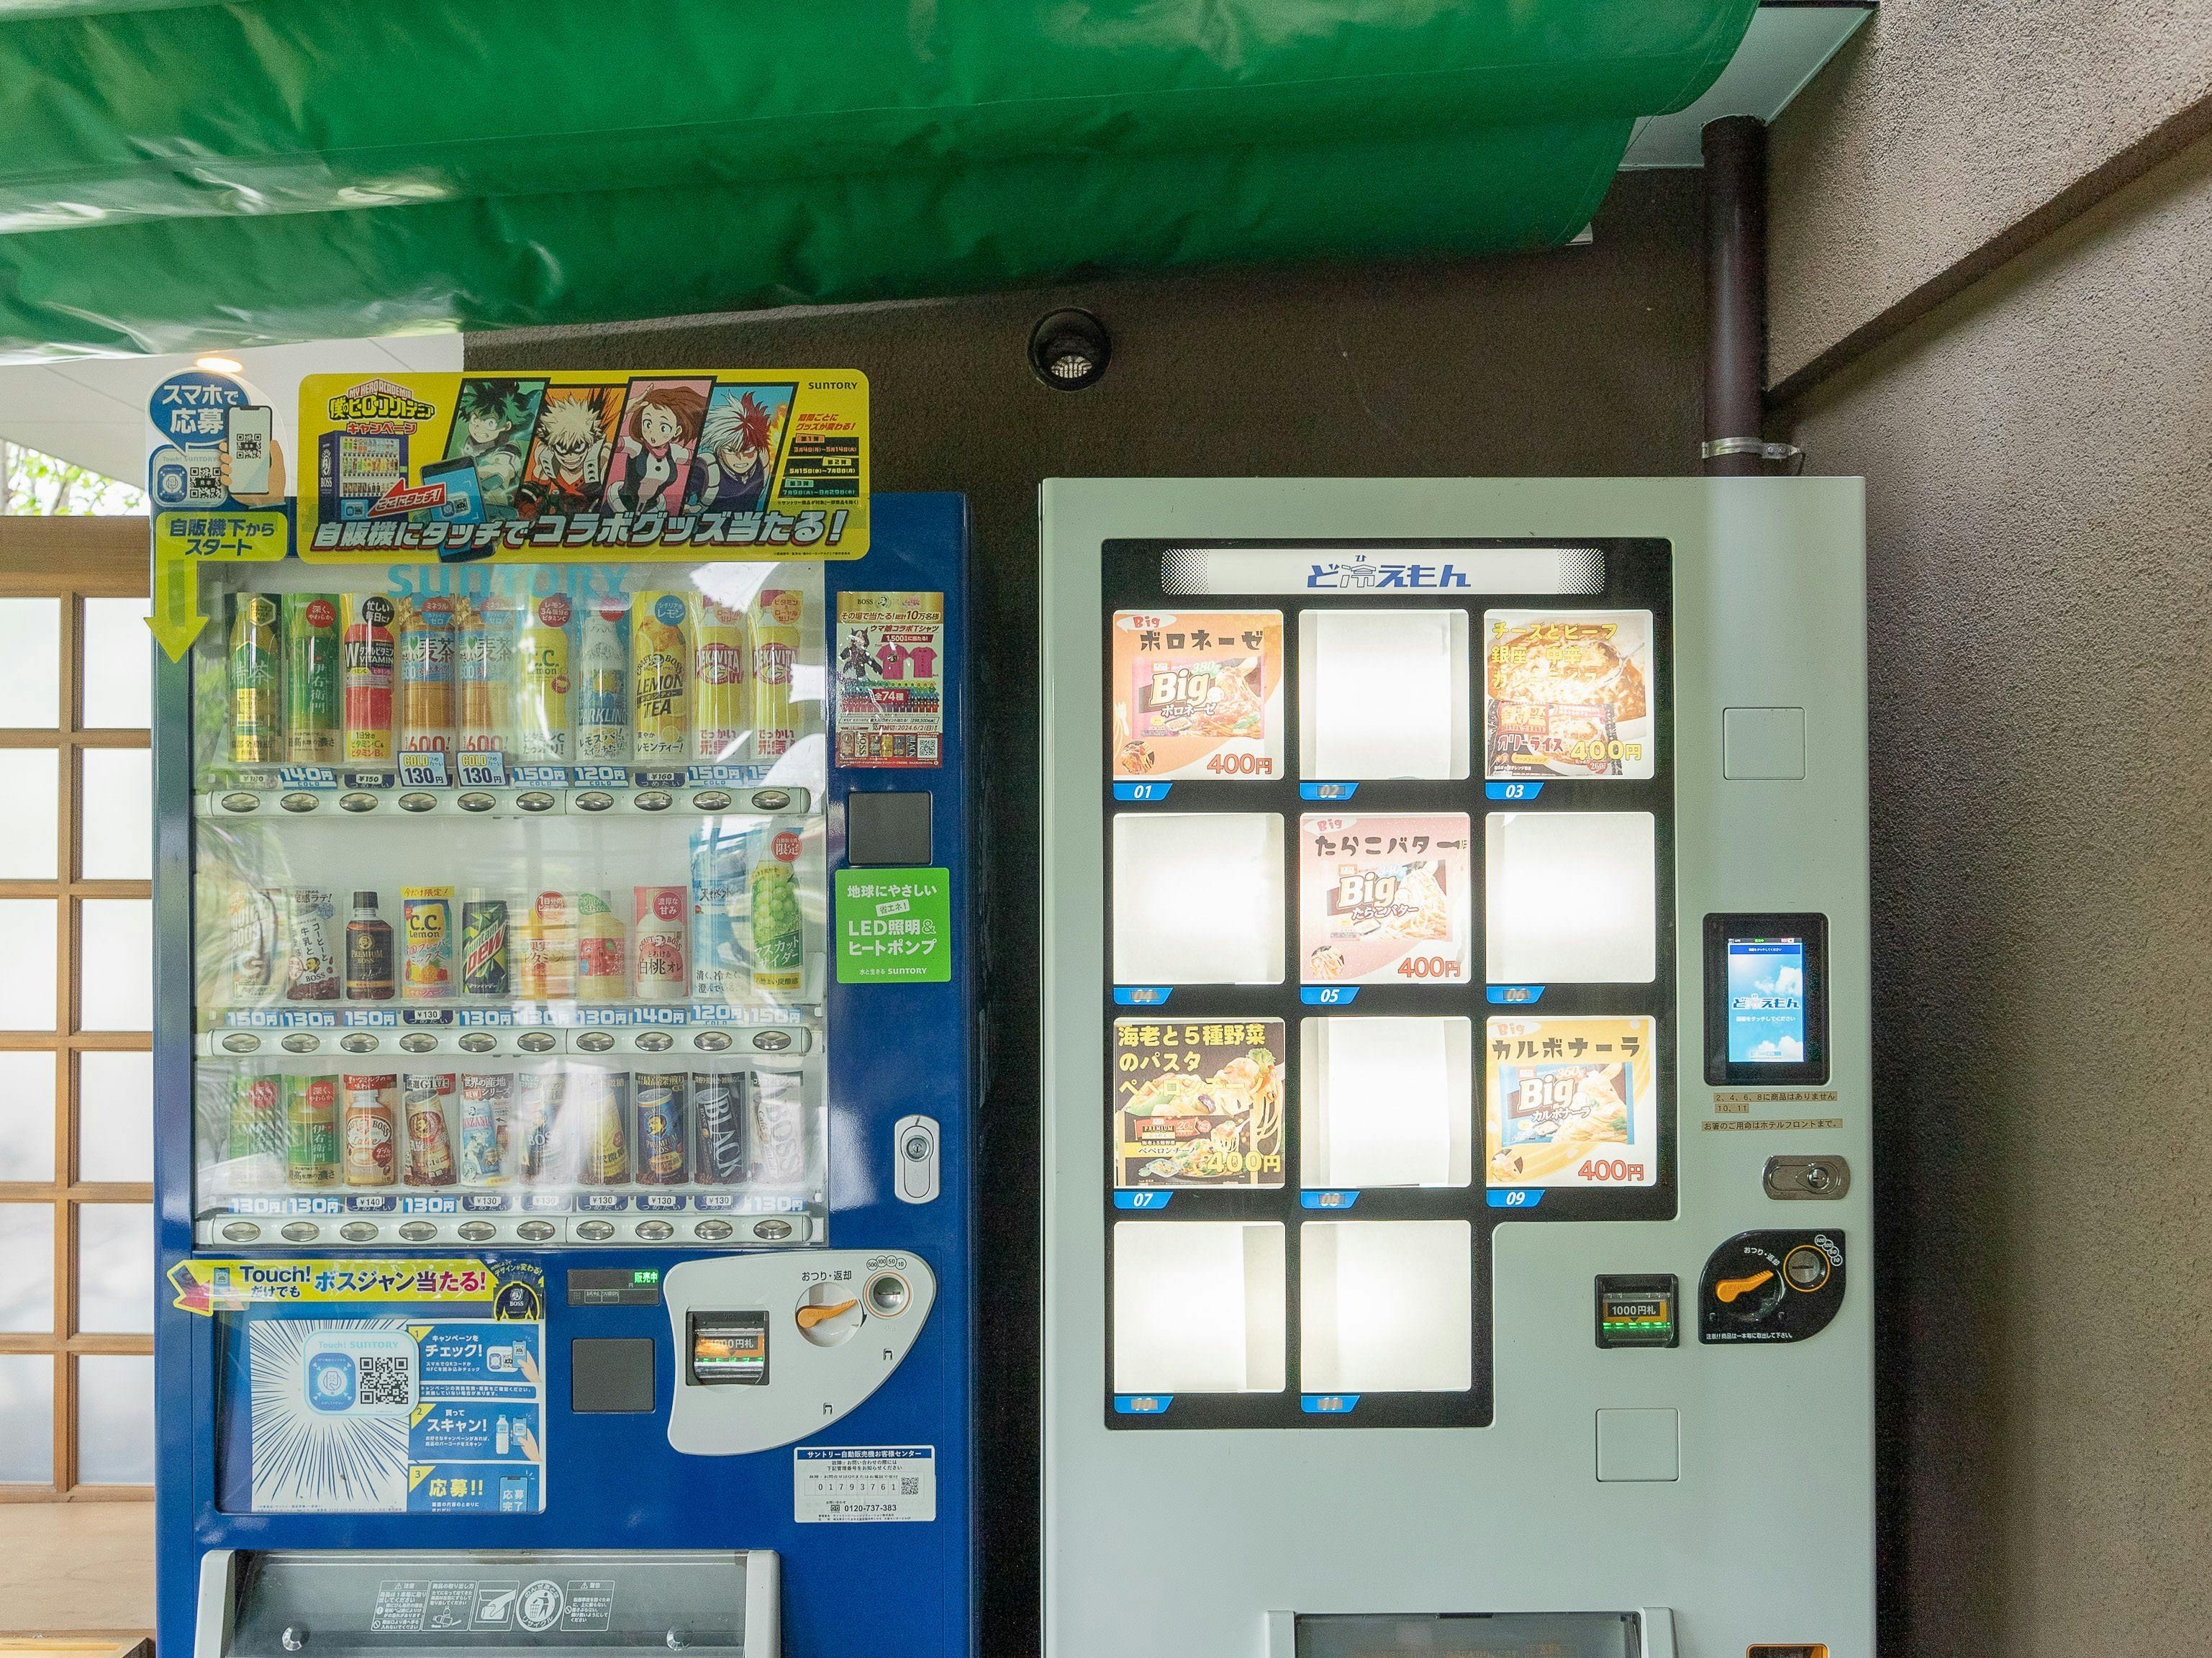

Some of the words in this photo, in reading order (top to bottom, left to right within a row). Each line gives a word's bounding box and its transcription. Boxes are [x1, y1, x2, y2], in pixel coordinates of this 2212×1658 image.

[163, 384, 239, 406] スマホで
[170, 408, 224, 435] 応募
[347, 422, 418, 435] キャンペーン
[169, 517, 276, 538] 自販機下から
[312, 509, 848, 550] 自販機にタッチでコラボグッズ当たる!
[185, 538, 253, 557] スタート
[1307, 563, 1472, 588] ど冷えもん
[366, 601, 390, 612] 忙しい
[1133, 617, 1161, 628] Big
[1492, 622, 1618, 640] チーズとビーフ
[1140, 630, 1264, 651] ボロネーゼ
[345, 643, 359, 667] W
[419, 637, 455, 662] 麦茶
[1490, 645, 1528, 664] 銀座
[637, 674, 683, 694] LEMON
[1150, 669, 1210, 707] Big
[643, 699, 671, 718] TEA
[1161, 703, 1218, 718] ボロネーゼ
[1570, 740, 1643, 761] 400円
[403, 755, 428, 766] COLD
[462, 755, 487, 766] COLD
[1207, 753, 1273, 775] 400円
[280, 768, 333, 781] 140円
[405, 767, 444, 784] 130円
[463, 767, 502, 784] 130円
[514, 766, 566, 781] 150円
[576, 766, 626, 781] 120円
[689, 766, 740, 779] 150円
[1133, 785, 1153, 799] 01
[1505, 785, 1524, 798] 03
[1317, 818, 1343, 832] Big
[776, 843, 799, 856] 限定
[1315, 835, 1468, 856] たらこバター
[847, 884, 937, 898] 地球にやさしい
[1337, 871, 1397, 910] Big
[659, 906, 677, 915] 甘み
[879, 902, 907, 915] 省エネ!
[1351, 904, 1419, 920] たらこバター
[409, 914, 442, 931] C.C.
[848, 919, 937, 936] LED照明&
[409, 930, 440, 939] Lemon
[754, 936, 799, 957] マスカット
[849, 938, 937, 956] ヒートポンプ
[640, 959, 682, 975] 白桃オレ
[1397, 956, 1461, 978] 400円
[305, 973, 326, 983] BOSS
[1320, 989, 1340, 1002] 05
[228, 1012, 278, 1025] 150円
[286, 1012, 335, 1025] 130円
[345, 1011, 395, 1025] 150円
[462, 1010, 513, 1025] 130円
[576, 1010, 627, 1025] 130円
[635, 1008, 684, 1023] 140円
[694, 1005, 742, 1020] 120円
[750, 1008, 800, 1023] 150円
[1118, 1023, 1265, 1047] 海老と5種野菜
[1497, 1023, 1526, 1035] Big
[1492, 1037, 1640, 1059] カルボナーラ
[1119, 1051, 1202, 1072] のパスタ
[464, 1077, 506, 1087] 世界の産地
[1119, 1077, 1264, 1096] ペペロンチーノ
[1517, 1074, 1575, 1113] Big
[1531, 1105, 1591, 1123] カルボナーラ
[312, 1125, 327, 1162] 伊右衛門
[704, 1100, 743, 1178] BLACK
[1206, 1151, 1282, 1173] 400円
[1578, 1159, 1645, 1182] 400円
[230, 1199, 279, 1213] 130円
[289, 1199, 338, 1213] 130円
[404, 1198, 455, 1212] 130円
[752, 1197, 803, 1211] 130円
[1133, 1194, 1153, 1208] 07
[1506, 1192, 1526, 1205] 09
[240, 1265, 310, 1282] Touch!
[314, 1270, 486, 1292] ボスジャン当たる!
[634, 1271, 658, 1283] 販売中
[802, 1269, 852, 1282] おつり・返却
[250, 1285, 301, 1297] だけでも
[1612, 1305, 1656, 1315] 1000円札
[425, 1344, 482, 1358] チェック!
[427, 1419, 486, 1433] スキャン!
[429, 1479, 484, 1498] 応募!!
[502, 1490, 525, 1500] 応募
[502, 1502, 523, 1512] 完了
[522, 1616, 554, 1628] リサイクル
